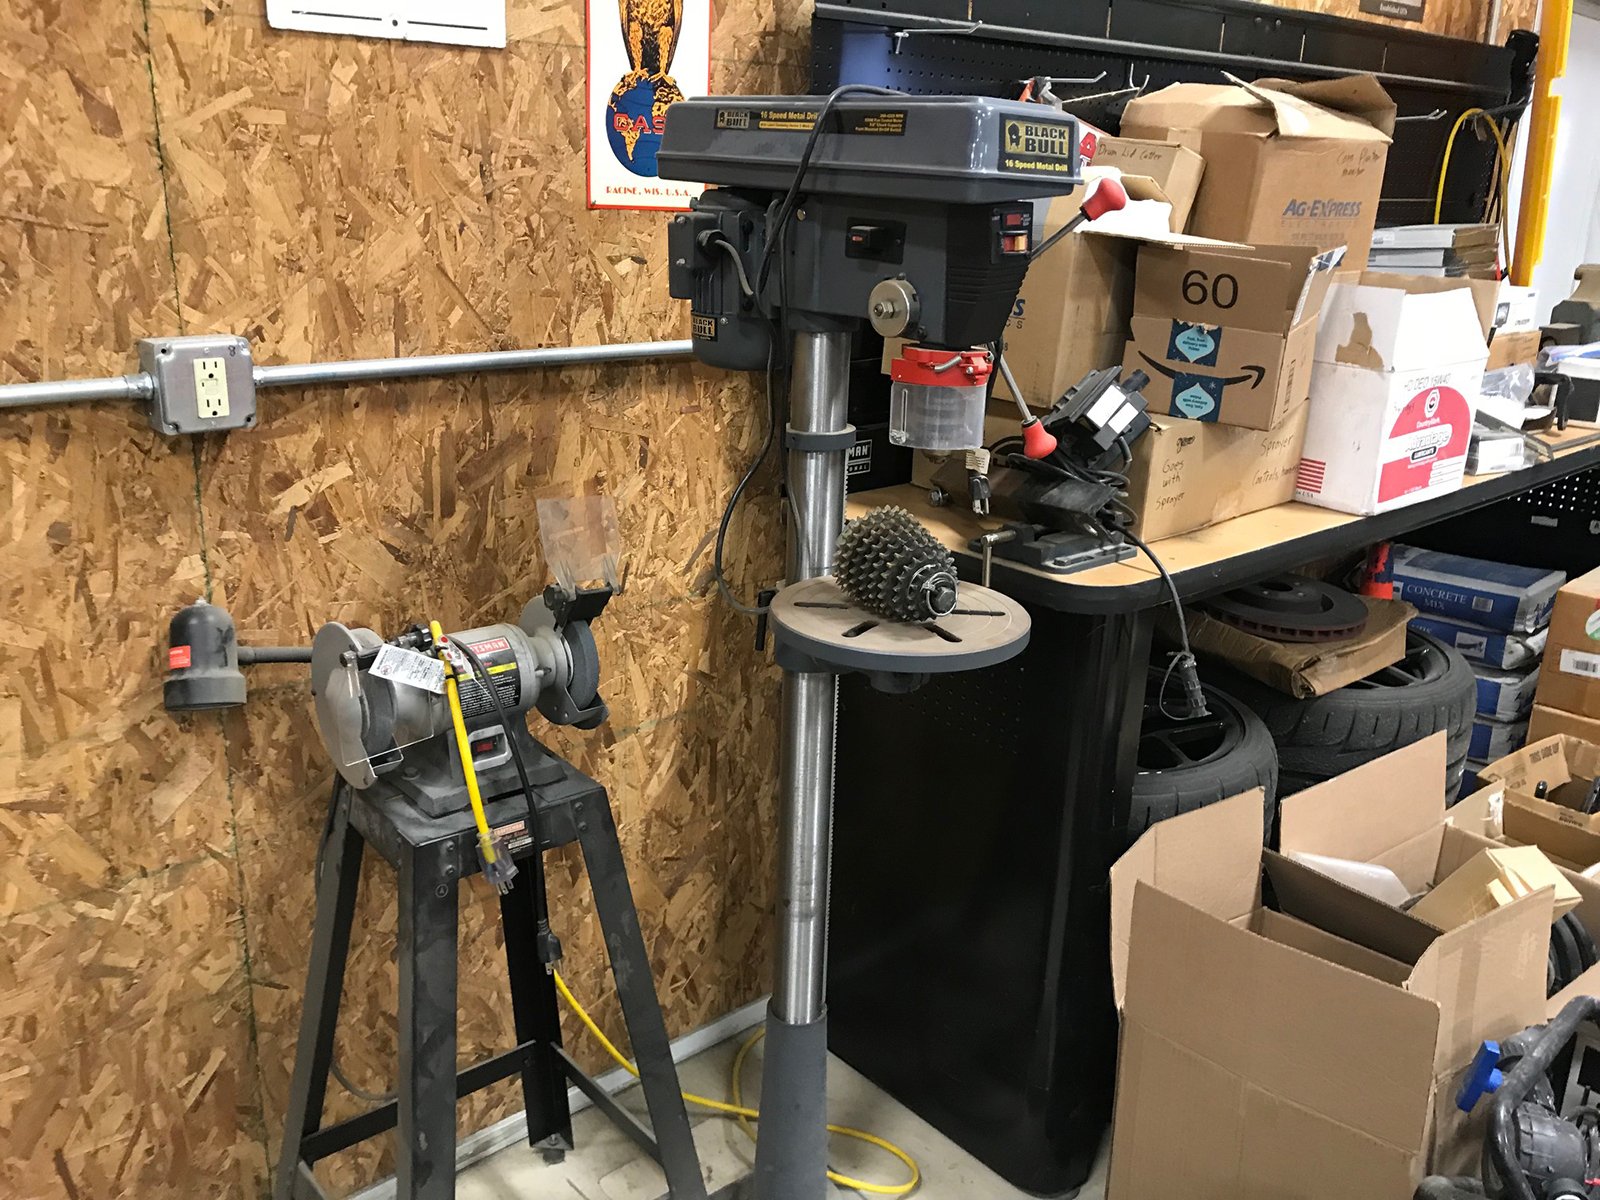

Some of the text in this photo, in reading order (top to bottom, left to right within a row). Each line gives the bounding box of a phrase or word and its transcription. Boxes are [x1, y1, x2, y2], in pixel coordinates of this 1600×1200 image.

[726, 118, 747, 127] BULL
[768, 111, 787, 121] Speed
[788, 112, 805, 120] Metal
[613, 113, 666, 135] CAS
[1025, 125, 1066, 139] BLACK
[1024, 138, 1066, 155] BULL
[1099, 143, 1117, 156] Drum
[1122, 147, 1137, 157] Lid
[1005, 159, 1068, 172] 16 Speed Metal Drill
[606, 186, 641, 196] RACINE,
[644, 187, 663, 196] WIS.
[1181, 269, 1239, 309] 60
[1162, 459, 1184, 473] Goes
[1162, 471, 1181, 487] with
[1407, 583, 1467, 605] CONCRETE
[1423, 598, 1445, 611] MIX
